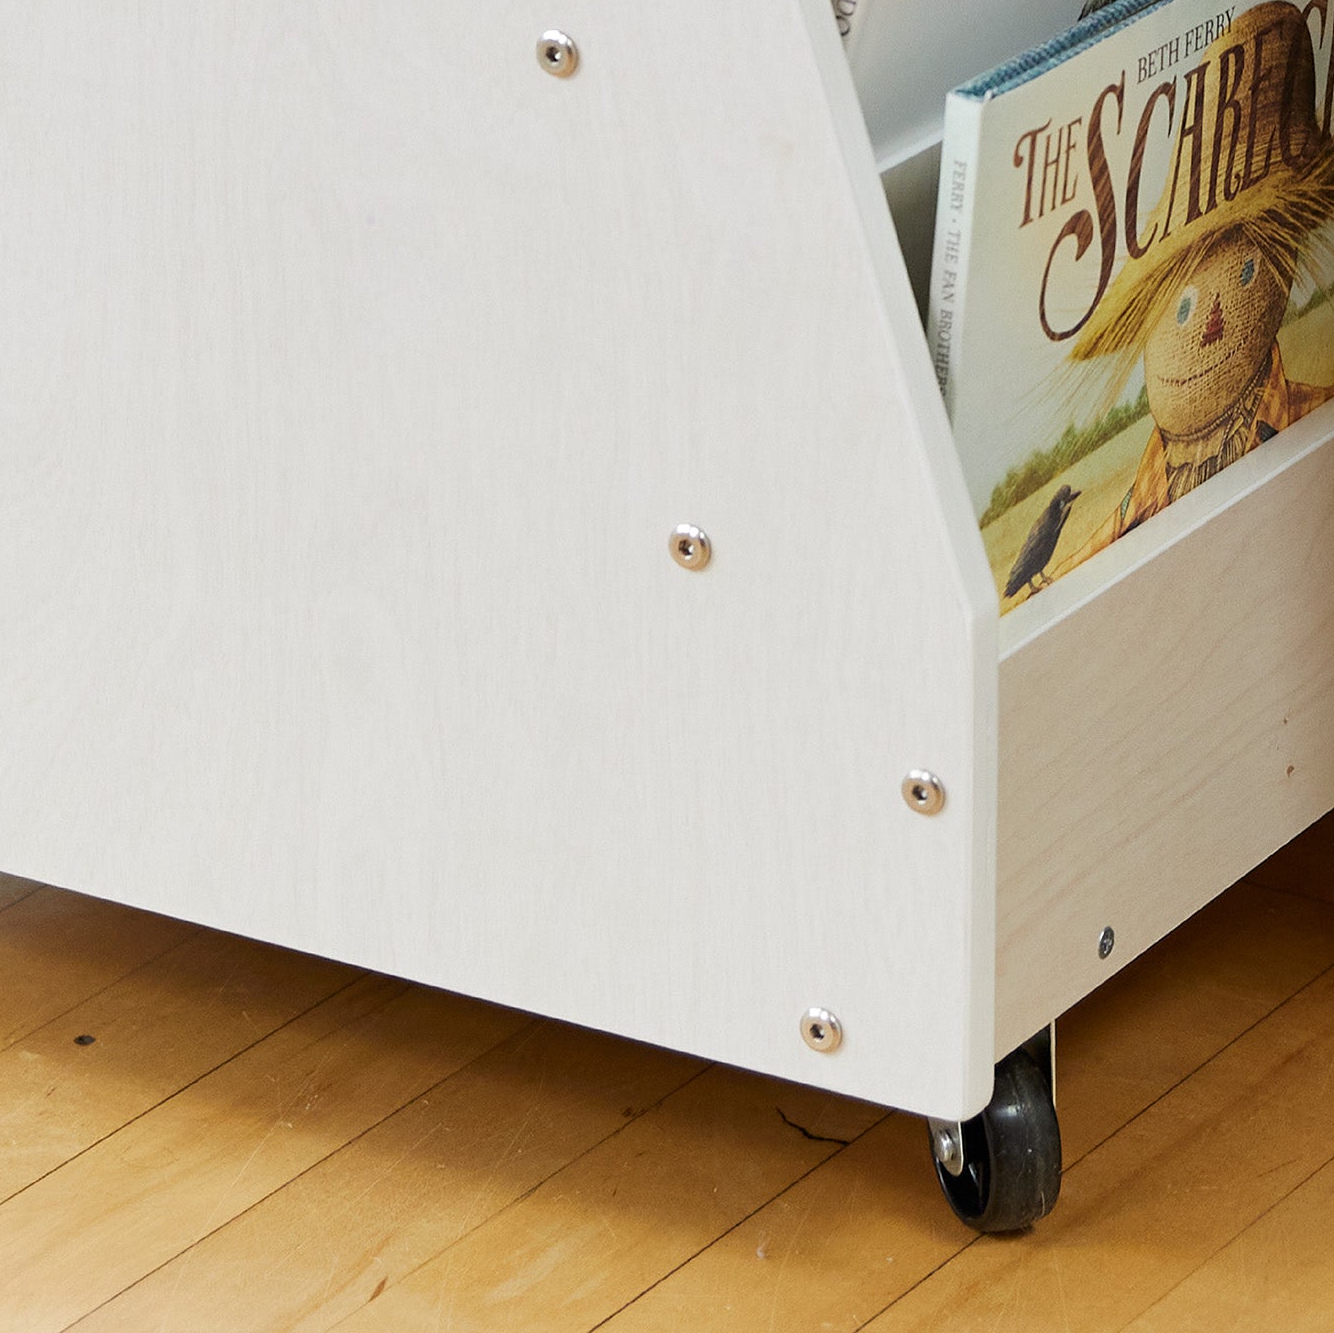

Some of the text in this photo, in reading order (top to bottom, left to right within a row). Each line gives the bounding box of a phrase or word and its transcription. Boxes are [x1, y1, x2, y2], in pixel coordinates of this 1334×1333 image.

[1137, 6, 1236, 85] BETH FERRY
[1013, 115, 1083, 229] THE
[934, 160, 968, 399] FERRY THE FAN BROTHERS
